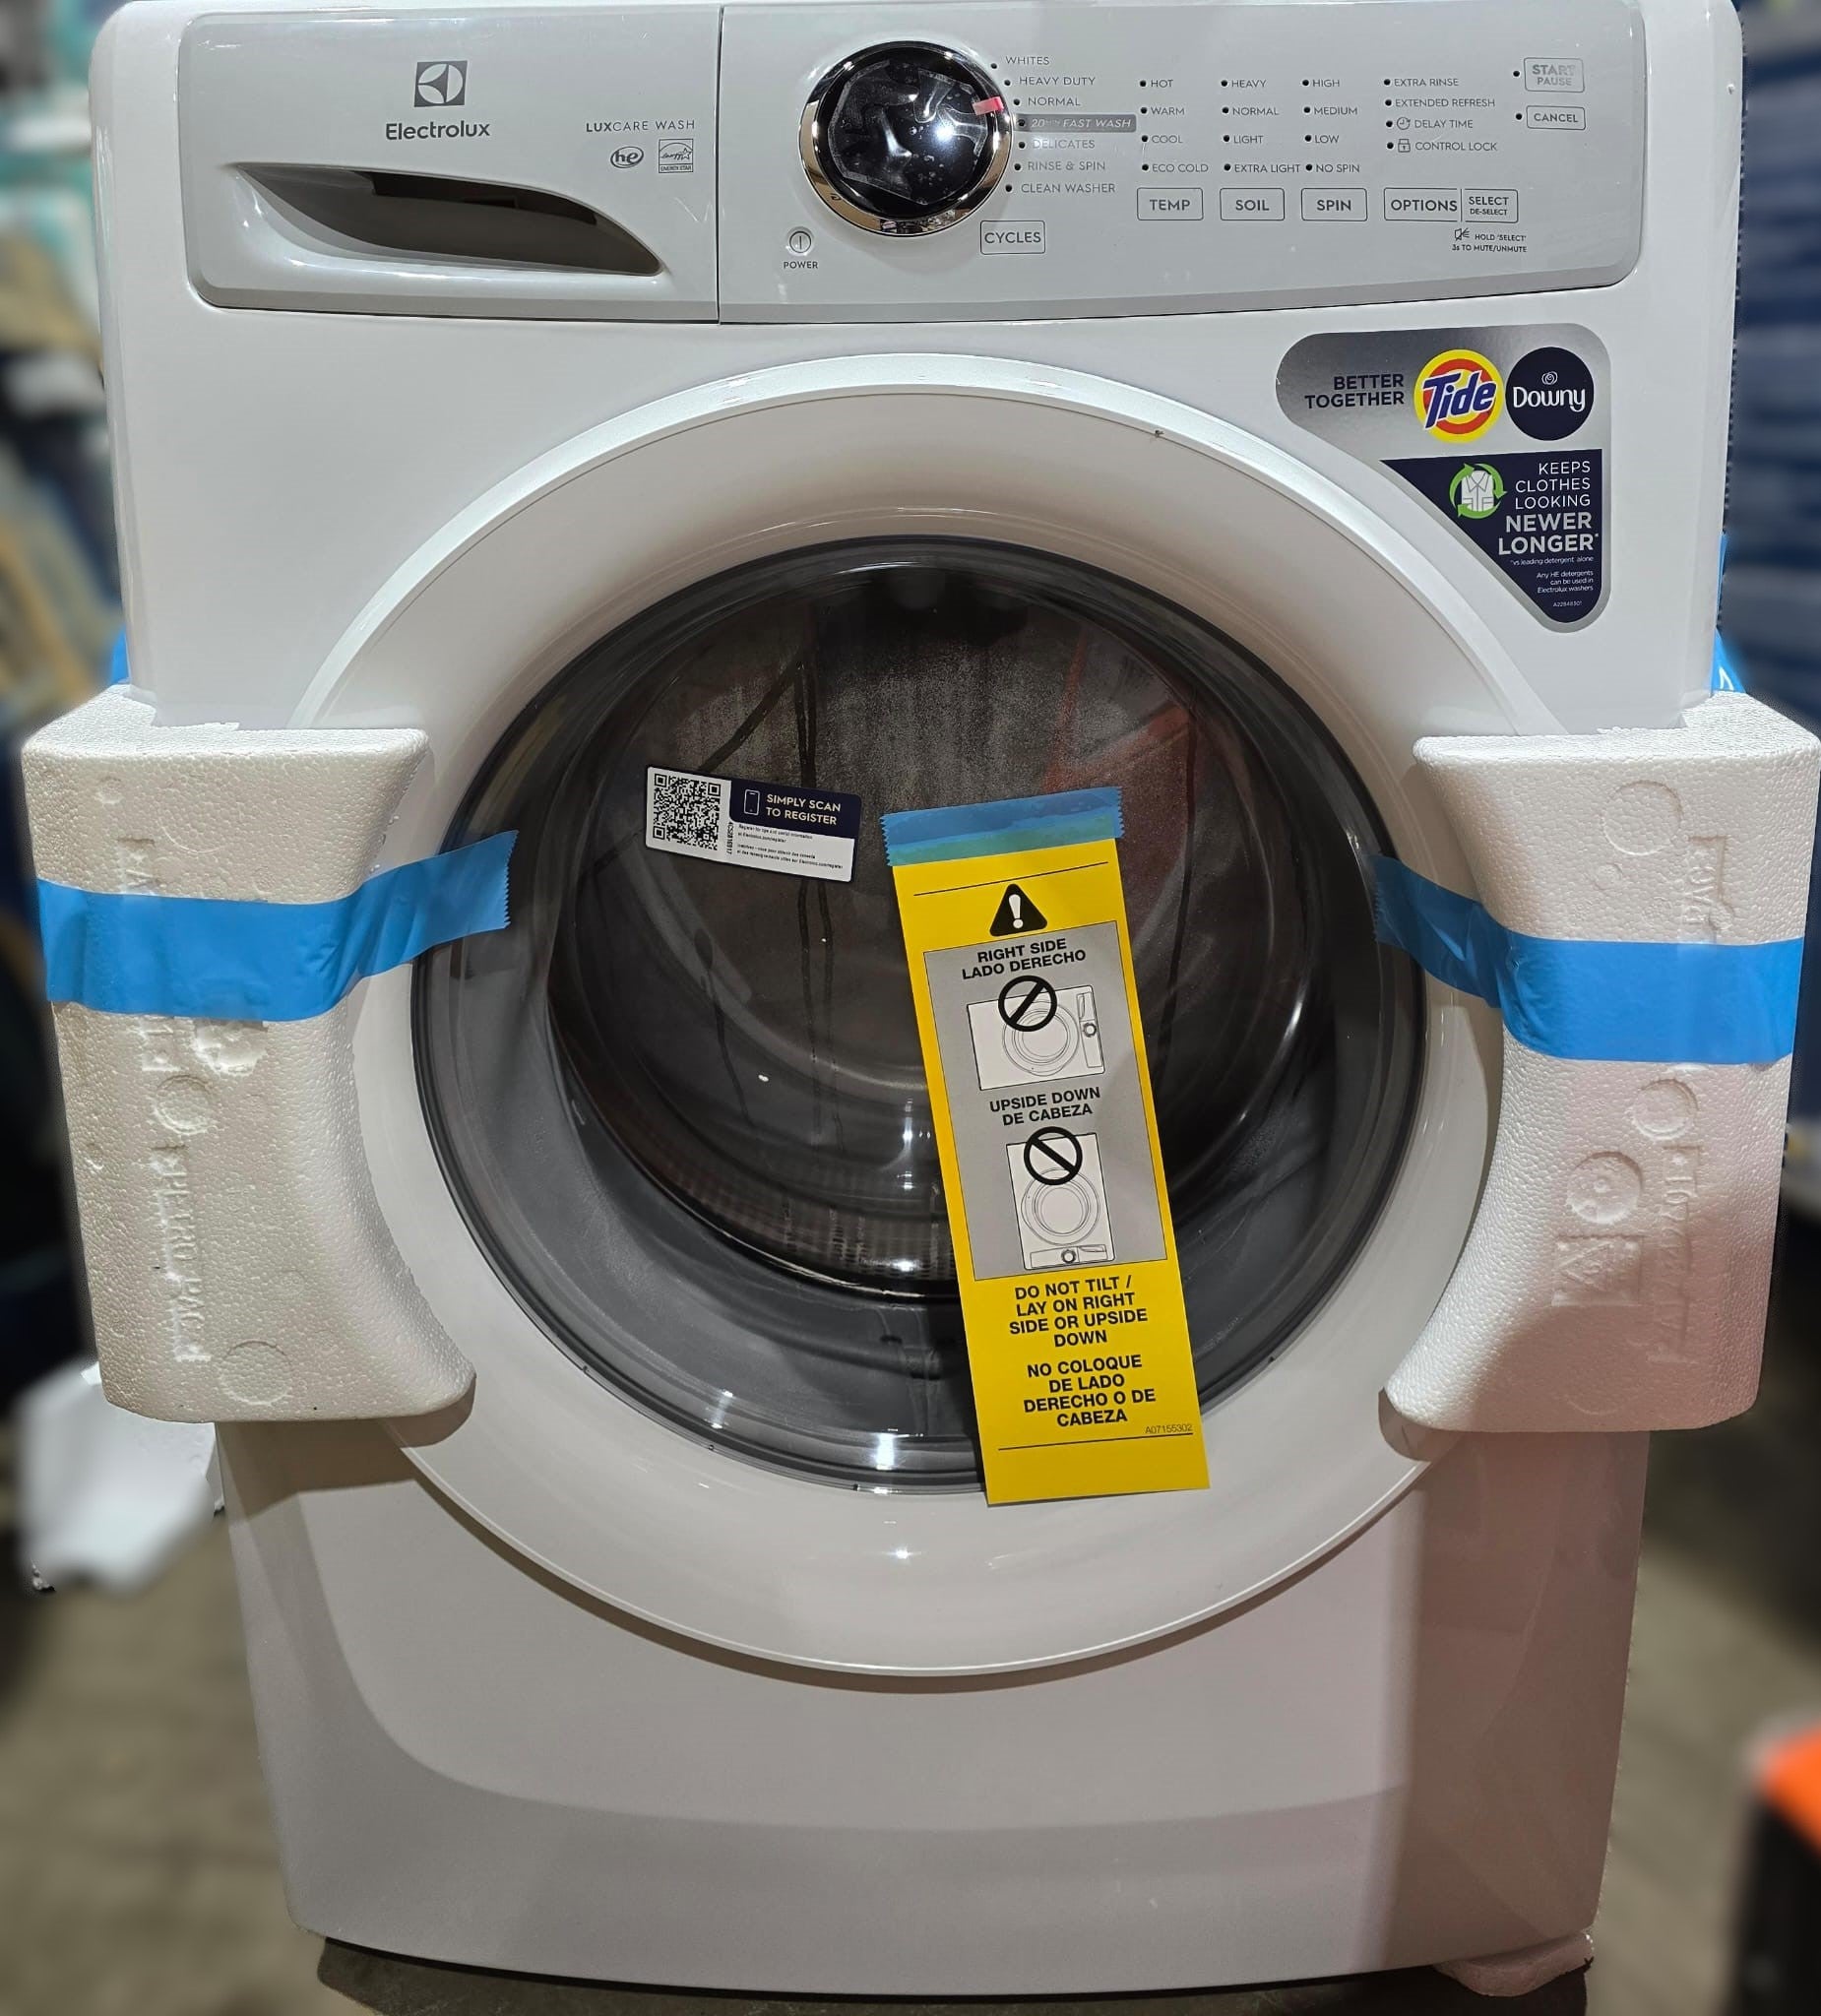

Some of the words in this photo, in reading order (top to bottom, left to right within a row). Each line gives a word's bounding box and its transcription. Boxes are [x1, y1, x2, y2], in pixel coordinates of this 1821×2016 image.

[1006, 56, 1049, 66] WHITES
[1532, 64, 1576, 76] START
[1019, 77, 1059, 86] HEAVY
[1063, 77, 1096, 86] DUTY
[1394, 78, 1426, 87] EXTRA
[1429, 78, 1459, 87] RINSE
[1537, 77, 1572, 86] PAUSE
[1028, 97, 1081, 106] NORMAL
[1395, 98, 1449, 107] EXTENDED
[1452, 98, 1495, 107] REFRESH
[1232, 107, 1280, 116] NORMAL
[1314, 106, 1358, 115] MEDIUM
[1063, 119, 1092, 128] FAST
[1096, 119, 1131, 128] WASH
[1414, 119, 1447, 129] DELAY
[1449, 119, 1474, 129] TIME
[1534, 113, 1579, 123] CANCEL
[386, 121, 490, 141] Electrolux
[586, 120, 649, 133] LUXCARE
[655, 119, 696, 131] WASH
[1033, 140, 1096, 149] DELICATES
[1152, 135, 1183, 144] COOL
[1414, 142, 1467, 151] CONTROL
[1469, 142, 1498, 152] LOCK
[1028, 161, 1062, 170] RINSE
[1066, 161, 1075, 171] &
[1079, 160, 1105, 170] SPIN
[1234, 164, 1268, 173] EXTRA
[1270, 164, 1300, 173] LIGHT
[1021, 183, 1060, 193] CLEAN
[1065, 183, 1115, 193] WASHER
[1150, 199, 1190, 211] TEMP
[1235, 200, 1270, 211] SOIL
[1316, 200, 1351, 211] SPIN
[1391, 199, 1458, 212] OPTIONS
[1469, 196, 1509, 206] SELECT
[984, 231, 1041, 244] CYCLES
[1334, 373, 1405, 391] BETTER
[1305, 392, 1405, 410] TOGETHER
[1422, 369, 1497, 430] Tide
[1513, 386, 1586, 412] Downy
[1538, 461, 1591, 475] KEEPS
[1516, 477, 1591, 493] CLOTHES
[1515, 494, 1591, 510] LOOKING
[1506, 512, 1592, 533] NEWER
[766, 793, 807, 808] SIMPLY
[809, 799, 842, 812] SCAN
[766, 806, 782, 818] TO
[785, 809, 837, 825] REGISTER
[977, 944, 1025, 963] RIGHT
[1030, 938, 1067, 954] SIDE
[962, 961, 1005, 980] LADO
[1010, 949, 1086, 973] DERECHO
[989, 1094, 1047, 1112] UPSIDE
[1051, 1087, 1100, 1104] DOWN
[1003, 1112, 1025, 1126] DE
[1029, 1103, 1093, 1122] CABEZA
[1015, 1286, 1039, 1300] DO
[1045, 1281, 1080, 1296] NOT
[1085, 1276, 1119, 1292] TILT
[1125, 1275, 1132, 1289] /
[1017, 1301, 1047, 1317] LAY
[1053, 1297, 1077, 1313] ON
[1083, 1292, 1135, 1310] RIGHT
[1009, 1318, 1049, 1335] SIDE
[1054, 1315, 1079, 1330] OR
[1085, 1308, 1148, 1327] UPSIDE
[1054, 1330, 1107, 1348] DOWN
[1028, 1362, 1051, 1378] NO
[1057, 1354, 1143, 1375] COLOQUE
[1049, 1379, 1073, 1393] DE
[1078, 1374, 1125, 1390] LADO
[1024, 1393, 1107, 1413] DERECHO
[1113, 1391, 1126, 1405] O
[1132, 1389, 1156, 1404] DE
[1057, 1409, 1128, 1427] CABEZA
[1145, 1423, 1193, 1434] A07155302
